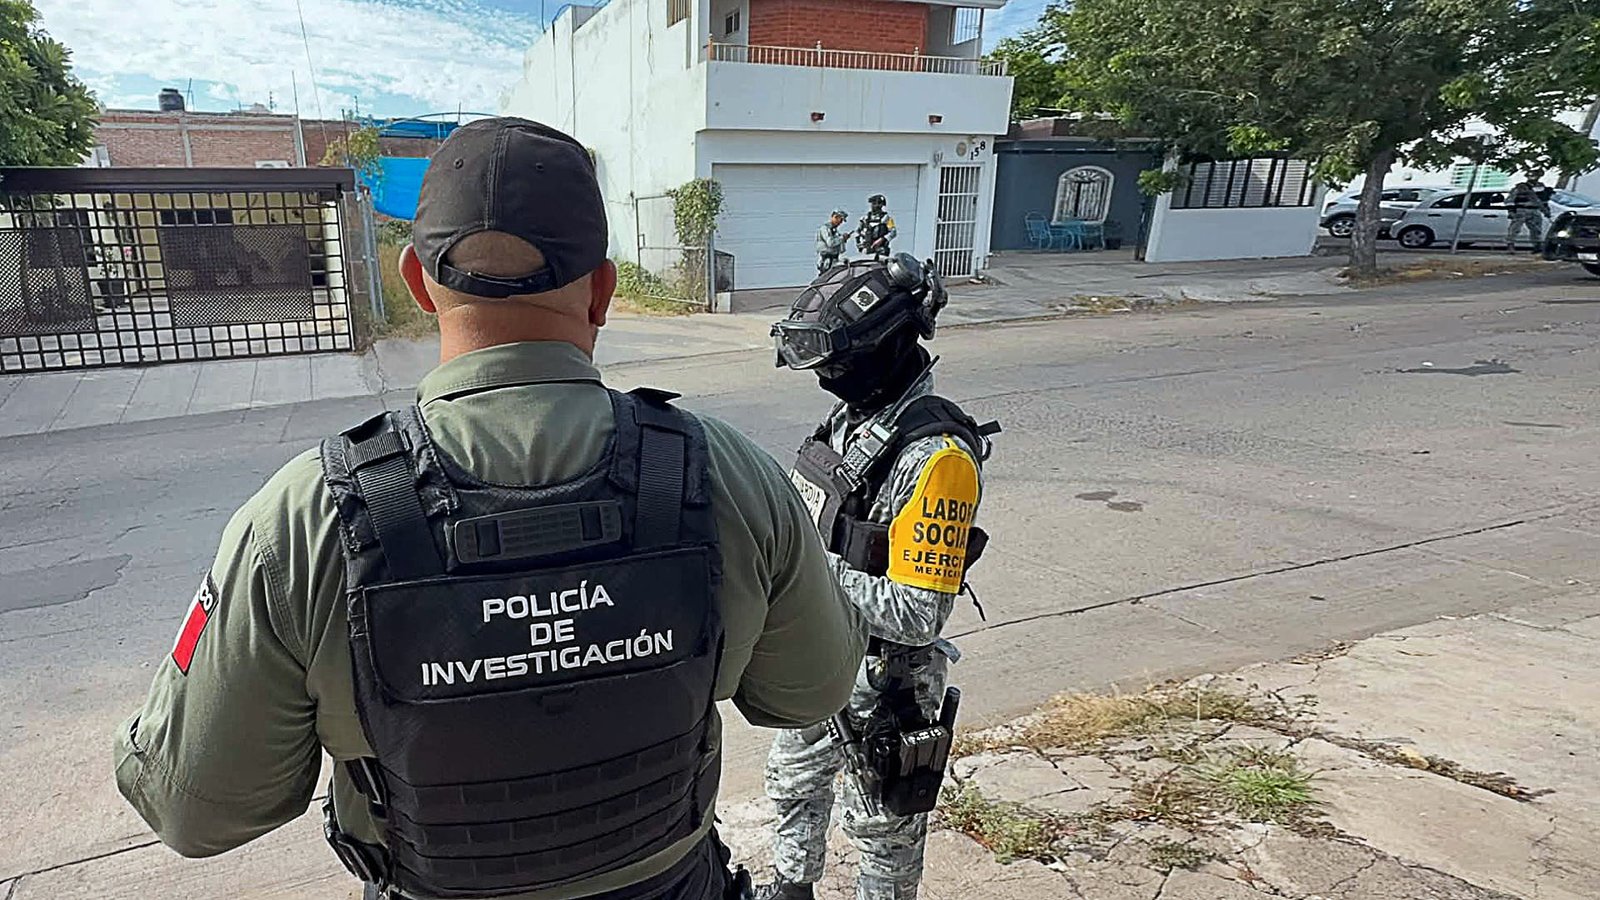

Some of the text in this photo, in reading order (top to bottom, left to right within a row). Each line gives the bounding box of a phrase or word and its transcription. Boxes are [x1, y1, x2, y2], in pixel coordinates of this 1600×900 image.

[970, 140, 986, 161] 158
[913, 521, 967, 549] SOCIA
[482, 580, 614, 622] POLICÍA
[530, 618, 575, 646] DE
[421, 628, 674, 686] INVESTIGACIÓN
